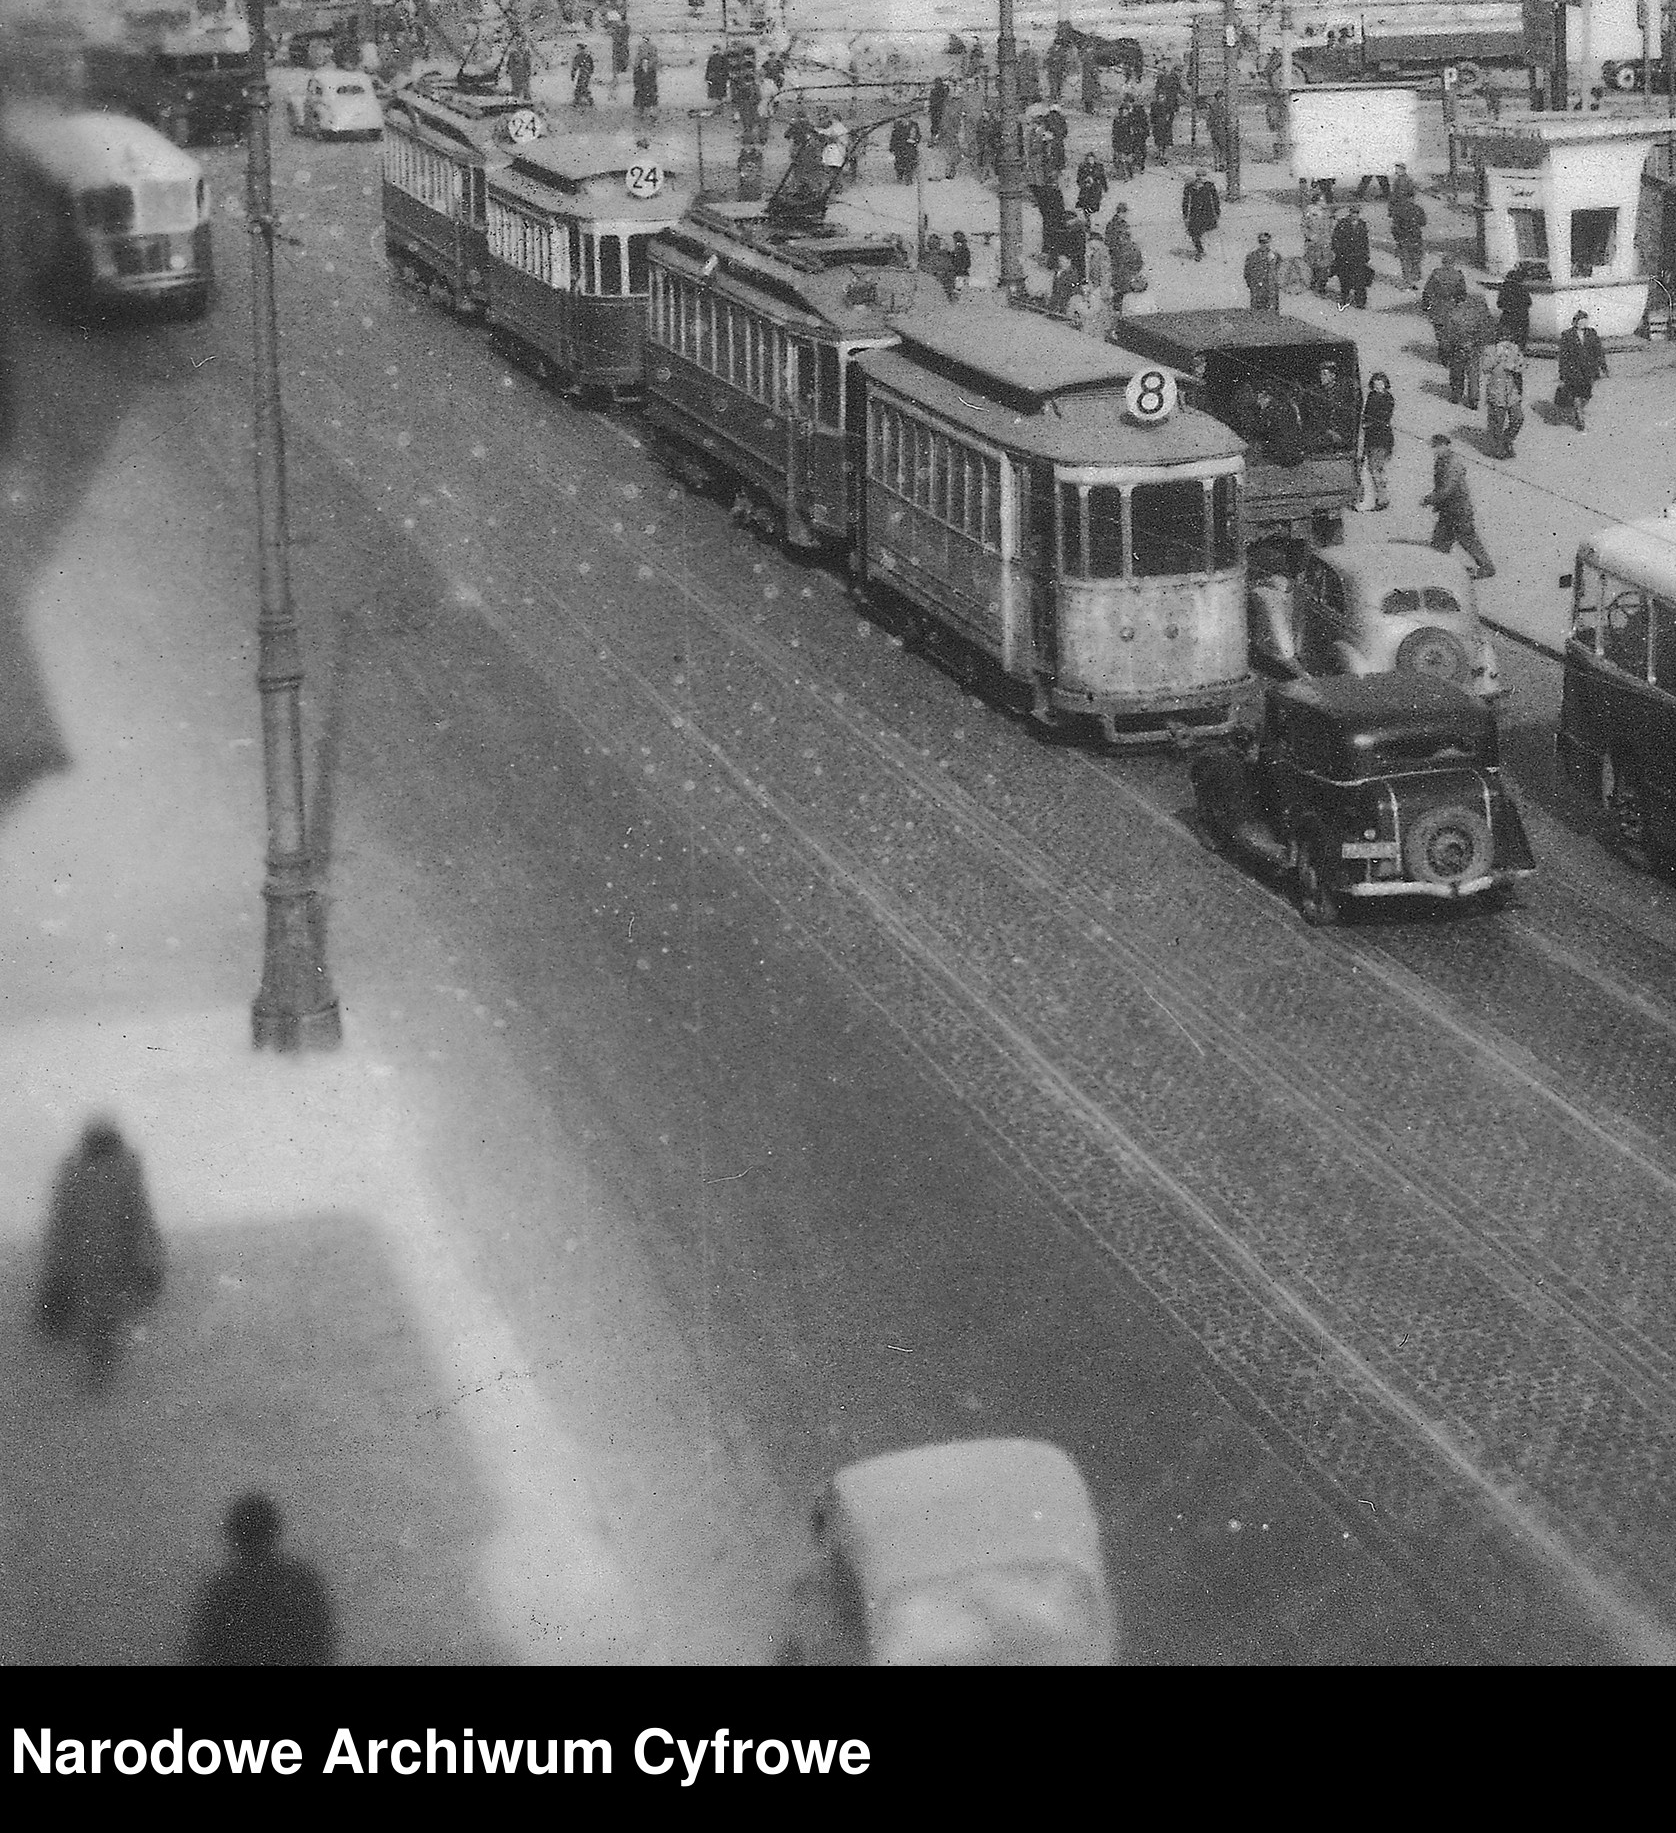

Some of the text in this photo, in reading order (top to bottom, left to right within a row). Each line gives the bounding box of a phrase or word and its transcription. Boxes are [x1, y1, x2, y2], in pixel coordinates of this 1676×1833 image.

[512, 117, 537, 138] 24
[630, 166, 659, 189] 24
[1136, 371, 1165, 415] 8
